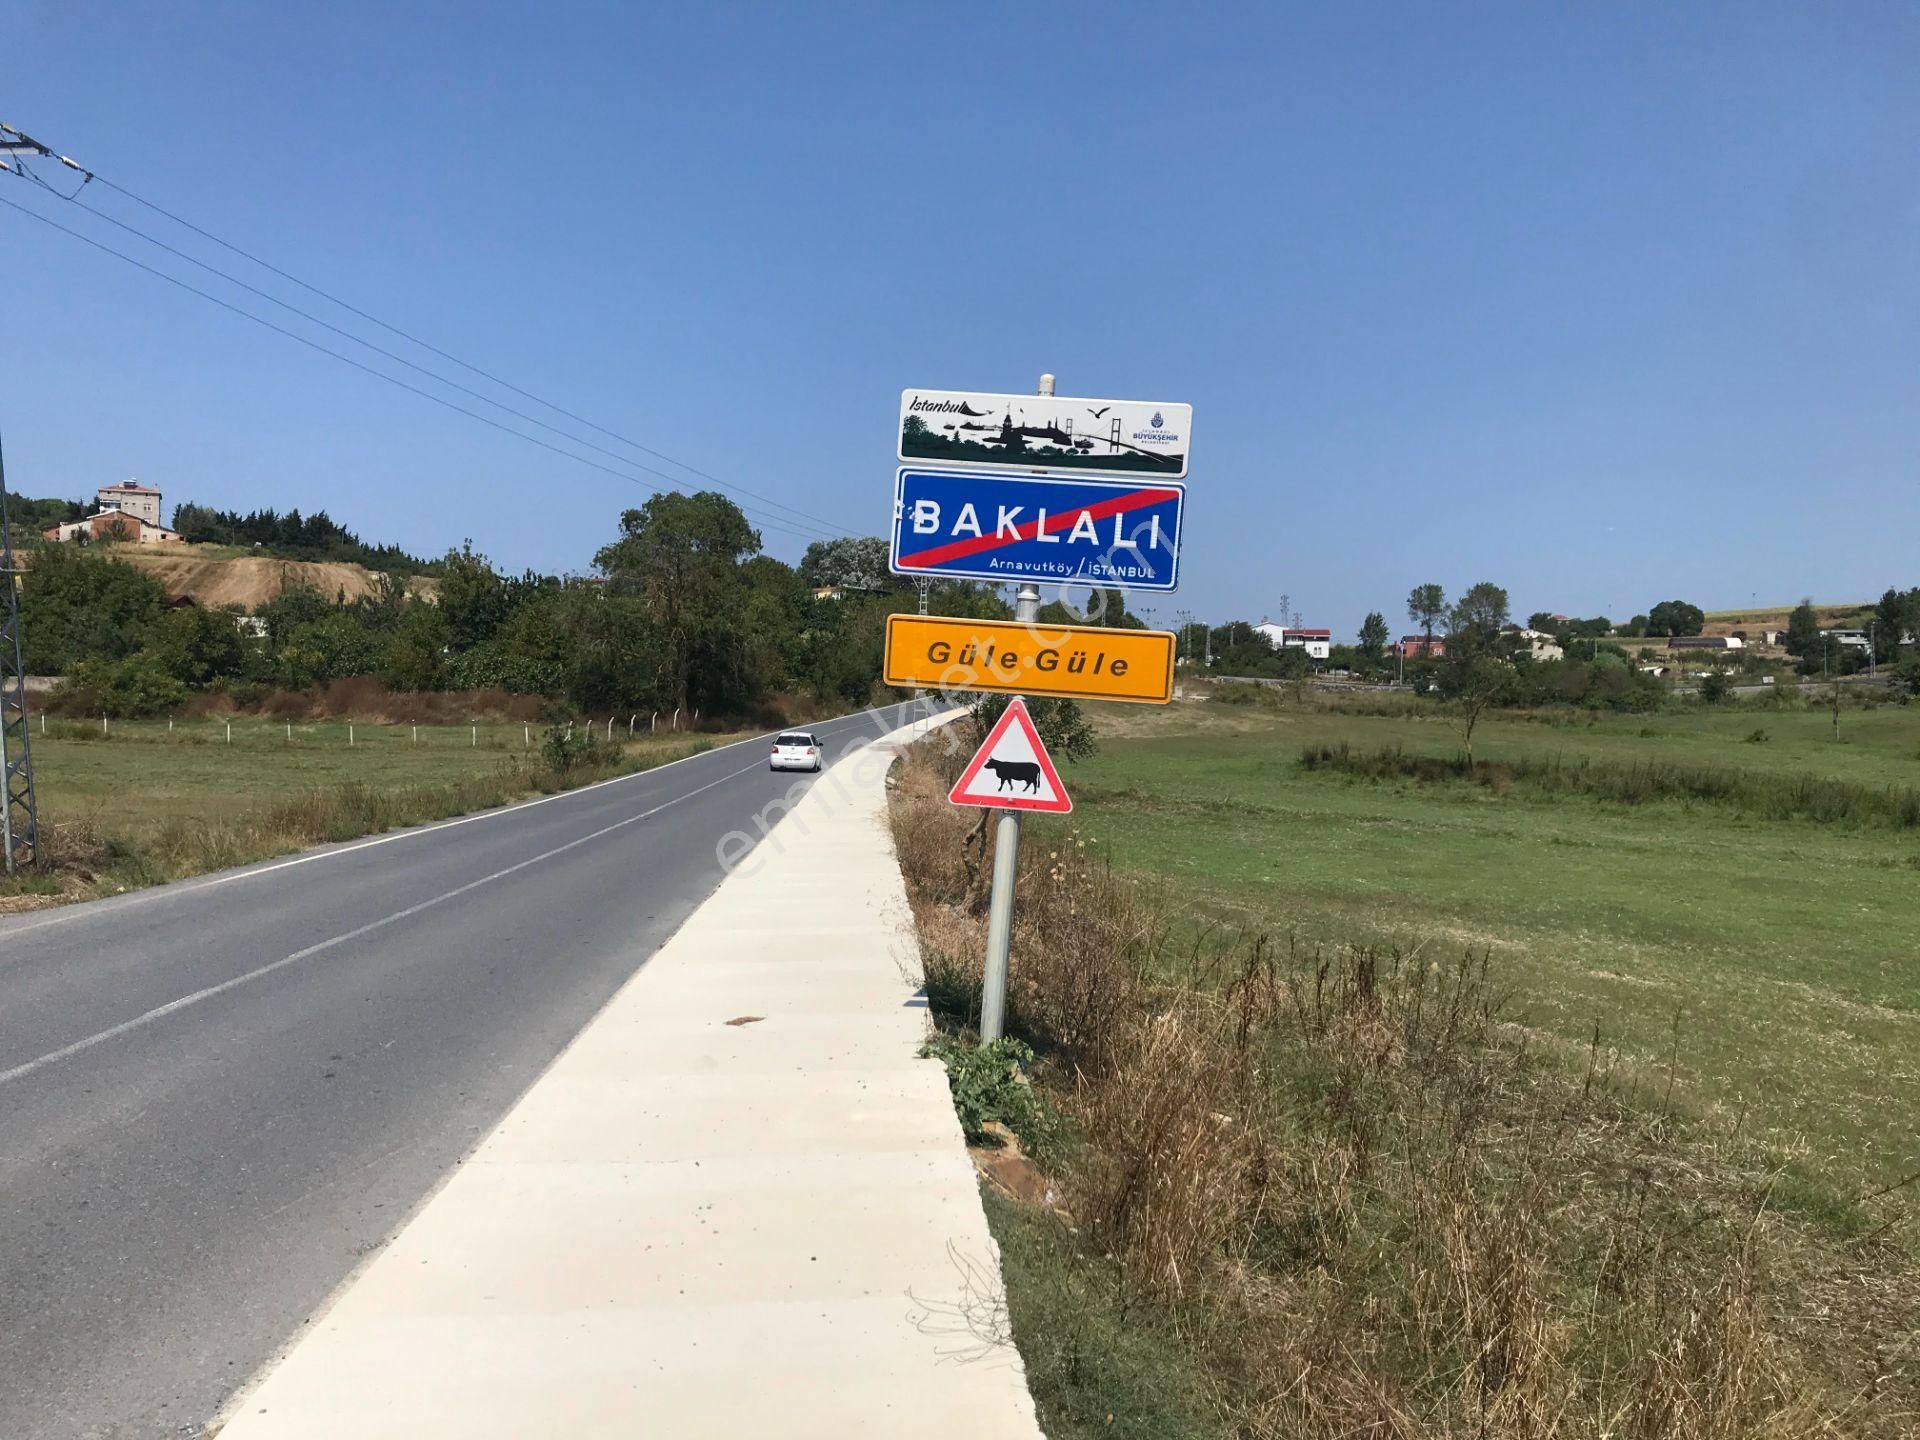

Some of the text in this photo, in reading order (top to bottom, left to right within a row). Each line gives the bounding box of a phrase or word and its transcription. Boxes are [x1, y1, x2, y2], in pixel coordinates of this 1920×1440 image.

[913, 499, 1159, 550] BAKLALI
[927, 641, 1129, 676] Güle Güle
